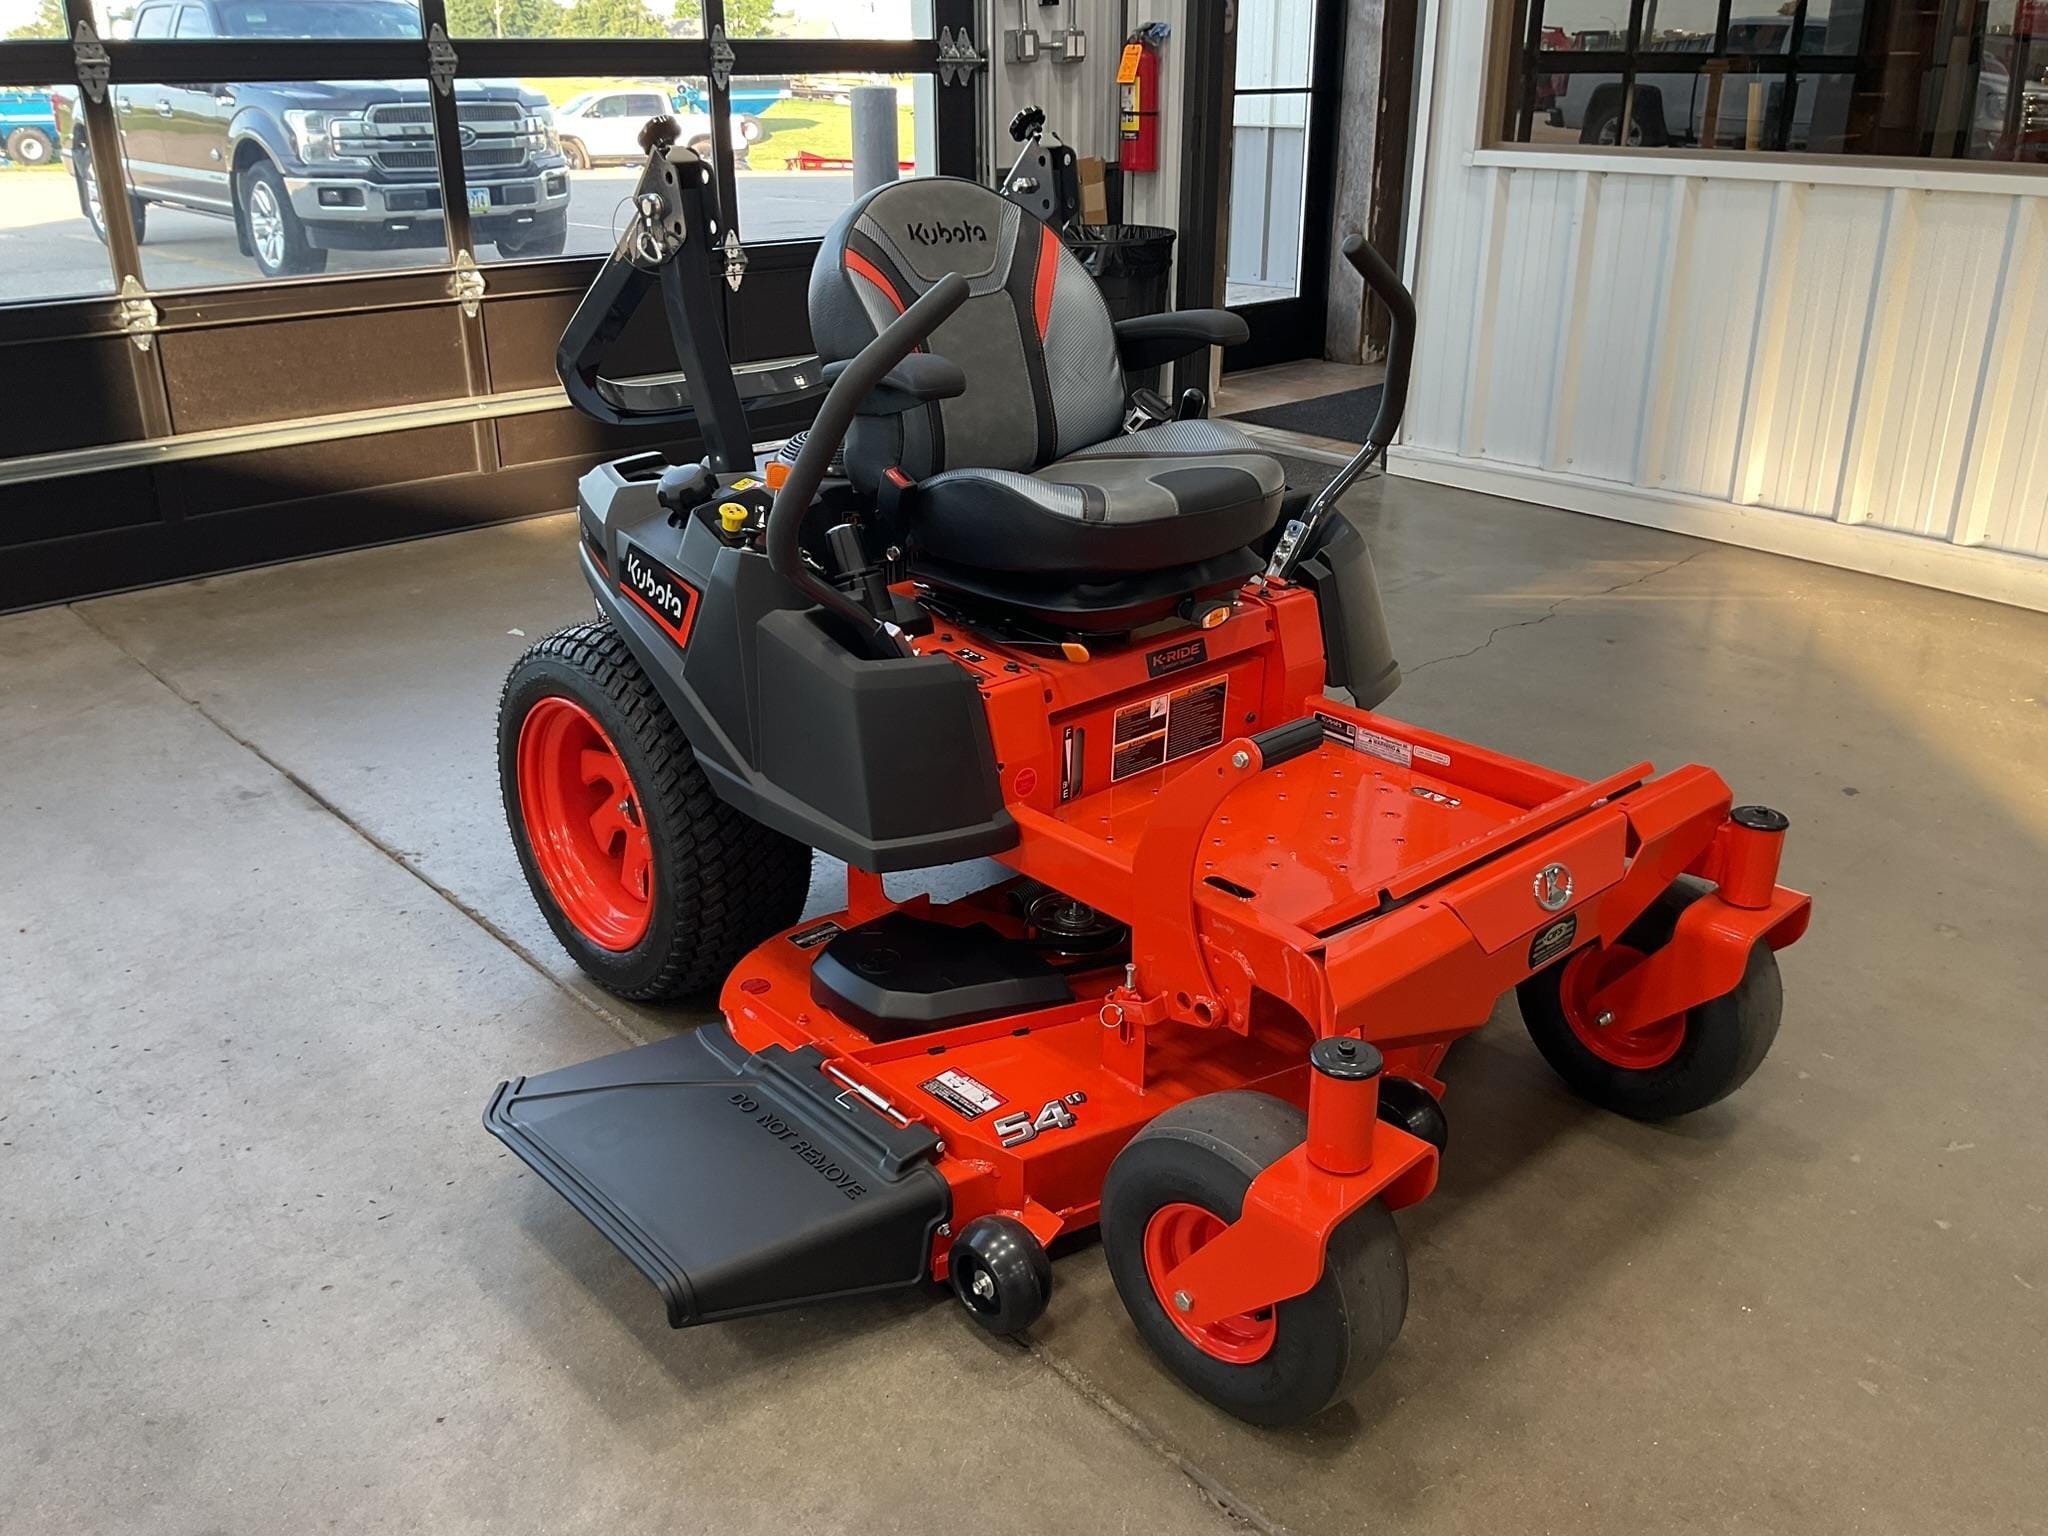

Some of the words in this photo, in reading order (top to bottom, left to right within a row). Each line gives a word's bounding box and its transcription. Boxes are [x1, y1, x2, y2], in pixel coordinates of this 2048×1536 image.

[907, 220, 987, 246] Kubota
[627, 553, 682, 619] Kubota
[1152, 643, 1201, 667] K-RIDE
[728, 1092, 759, 1113] DO
[756, 1112, 799, 1140] NOT
[790, 1139, 867, 1200] REMOVE
